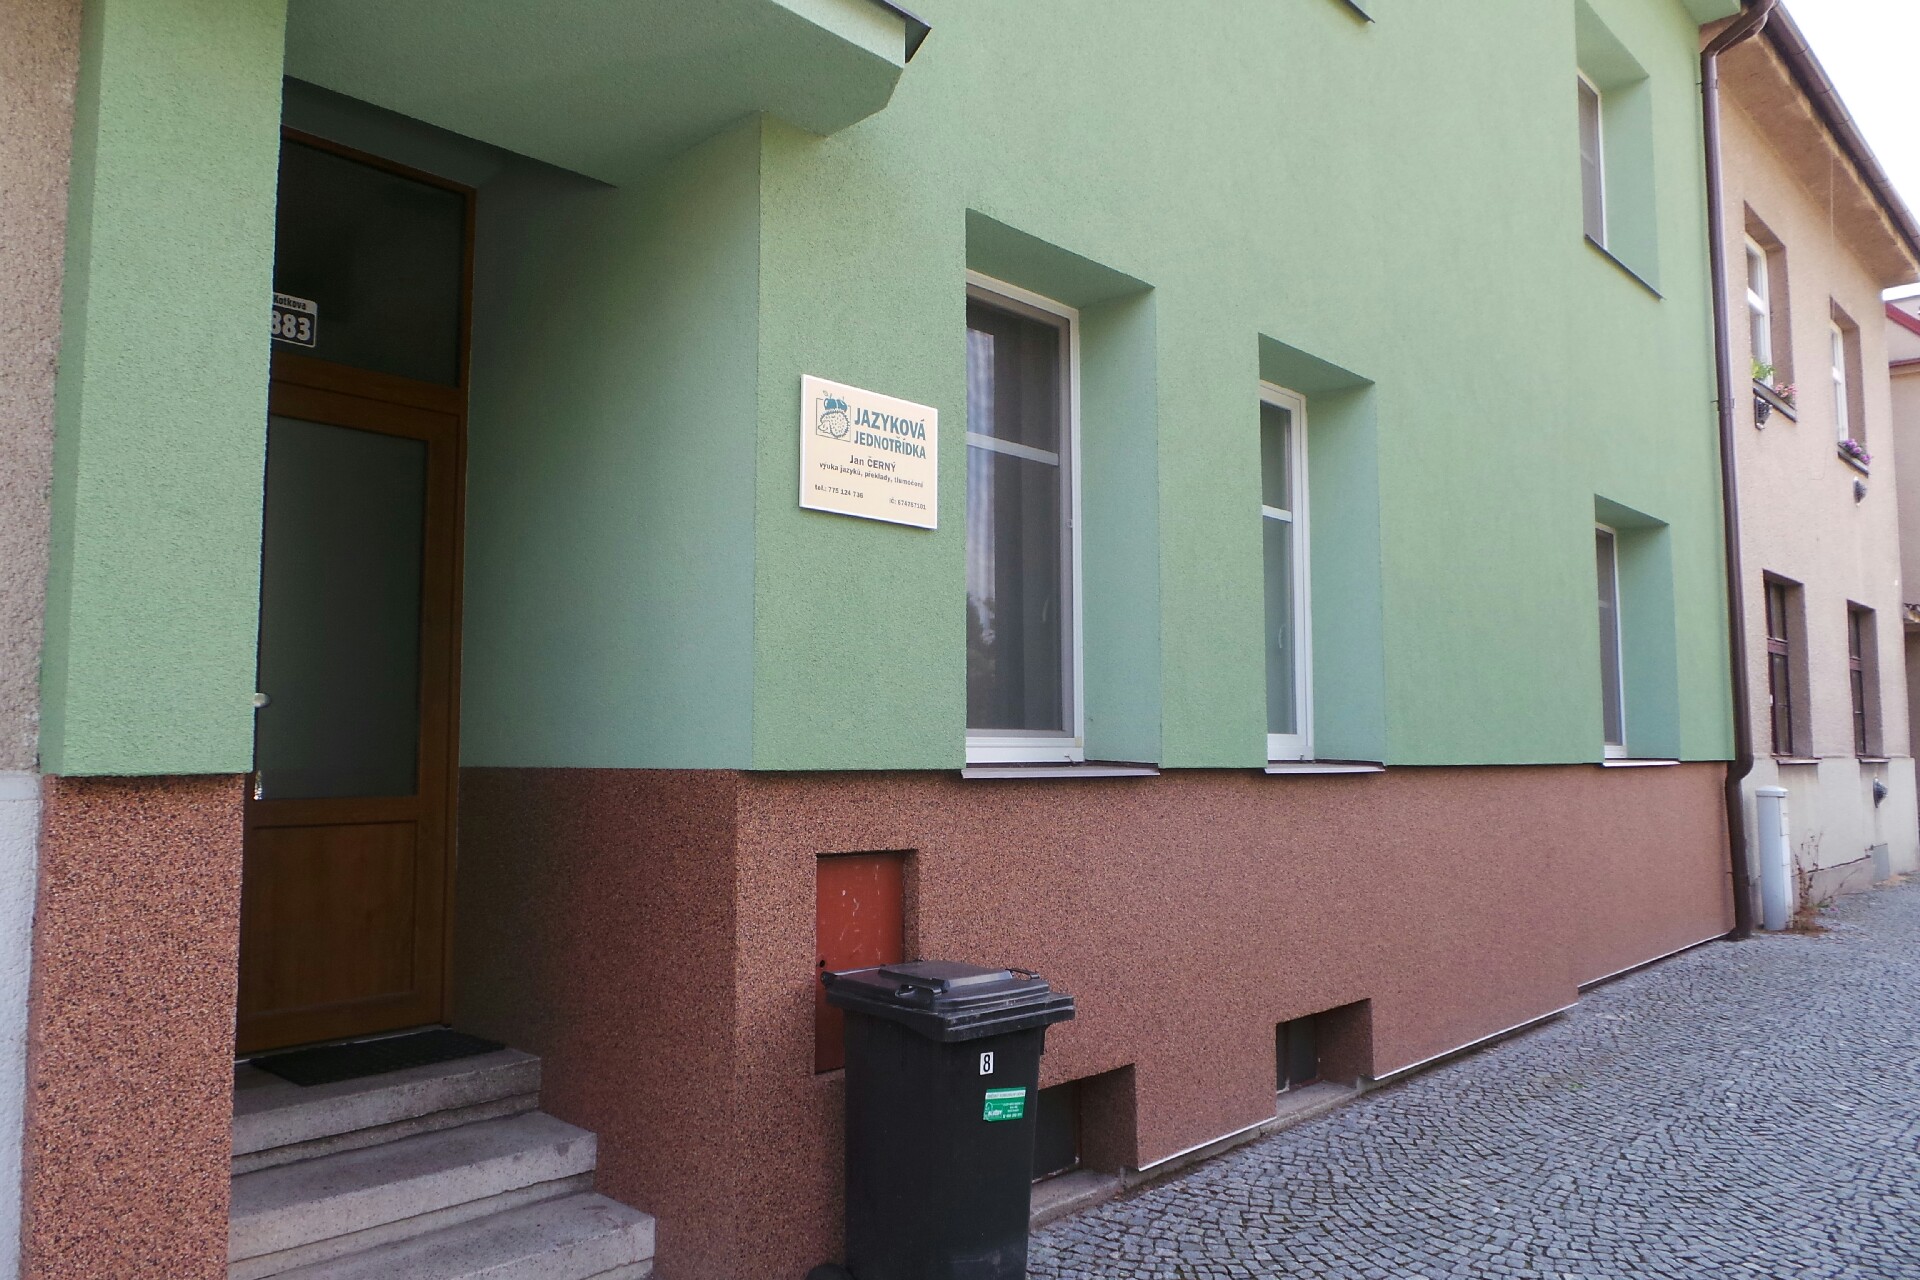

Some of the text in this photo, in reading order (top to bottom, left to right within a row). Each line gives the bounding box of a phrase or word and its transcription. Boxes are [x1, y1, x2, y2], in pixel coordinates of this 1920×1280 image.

[854, 407, 926, 441] JAZYKOVÁ
[854, 430, 926, 459] JEDNOTŘÍDKA
[819, 461, 839, 471] výuka
[864, 470, 893, 483] překlady,
[849, 454, 896, 473] Jan ČERNÝ
[983, 1054, 991, 1073] 8
